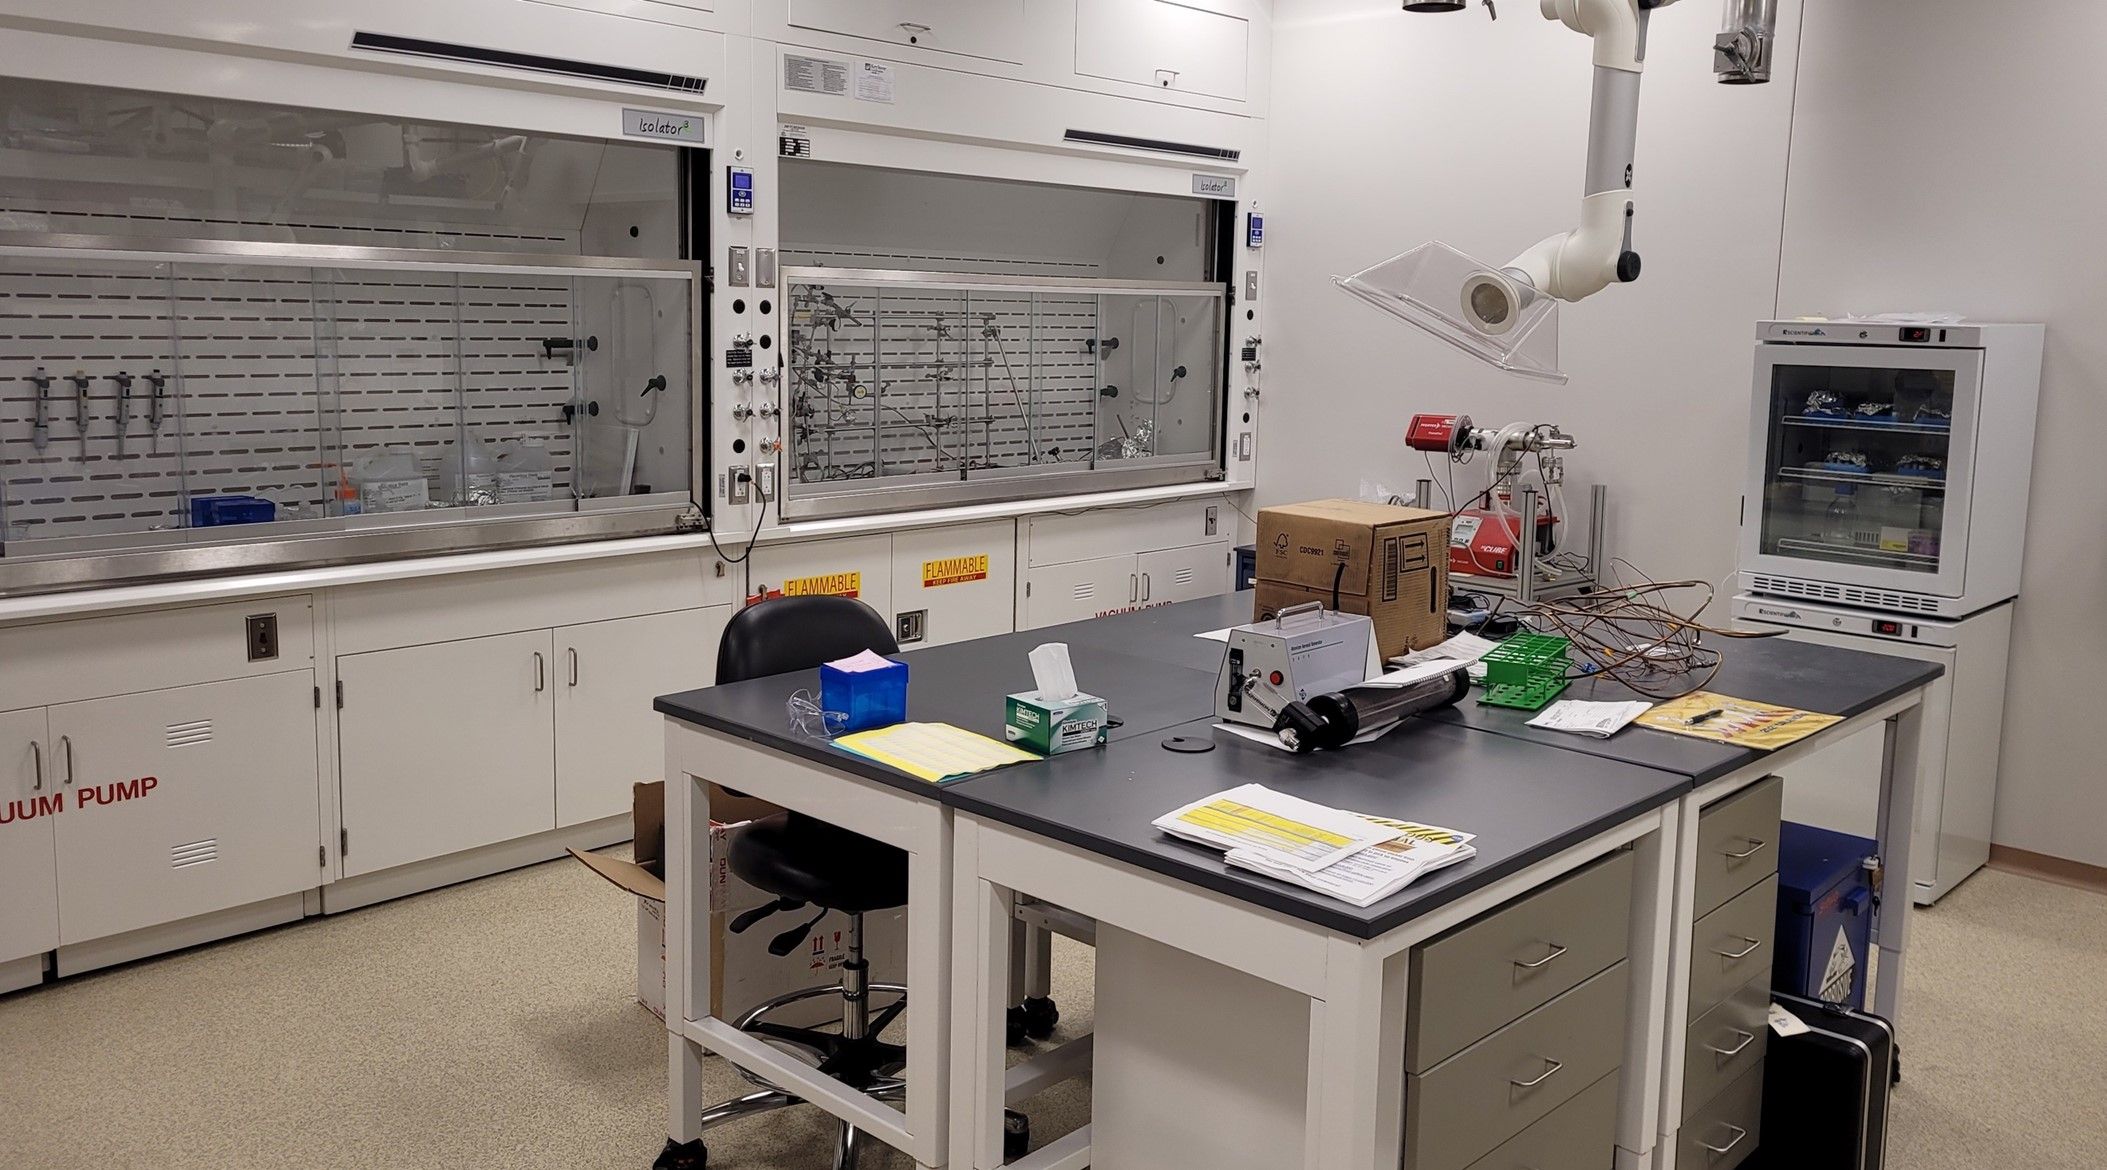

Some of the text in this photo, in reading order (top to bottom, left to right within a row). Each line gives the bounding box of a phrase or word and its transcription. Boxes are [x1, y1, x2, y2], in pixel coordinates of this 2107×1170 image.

[1300, 546, 1324, 556] CDC9921
[925, 555, 985, 579] FLAMMABLE
[787, 573, 857, 596] FLAMMABLE
[959, 574, 977, 582] AWAY
[1062, 720, 1098, 734] KIMTECH
[77, 776, 158, 809] PUMP
